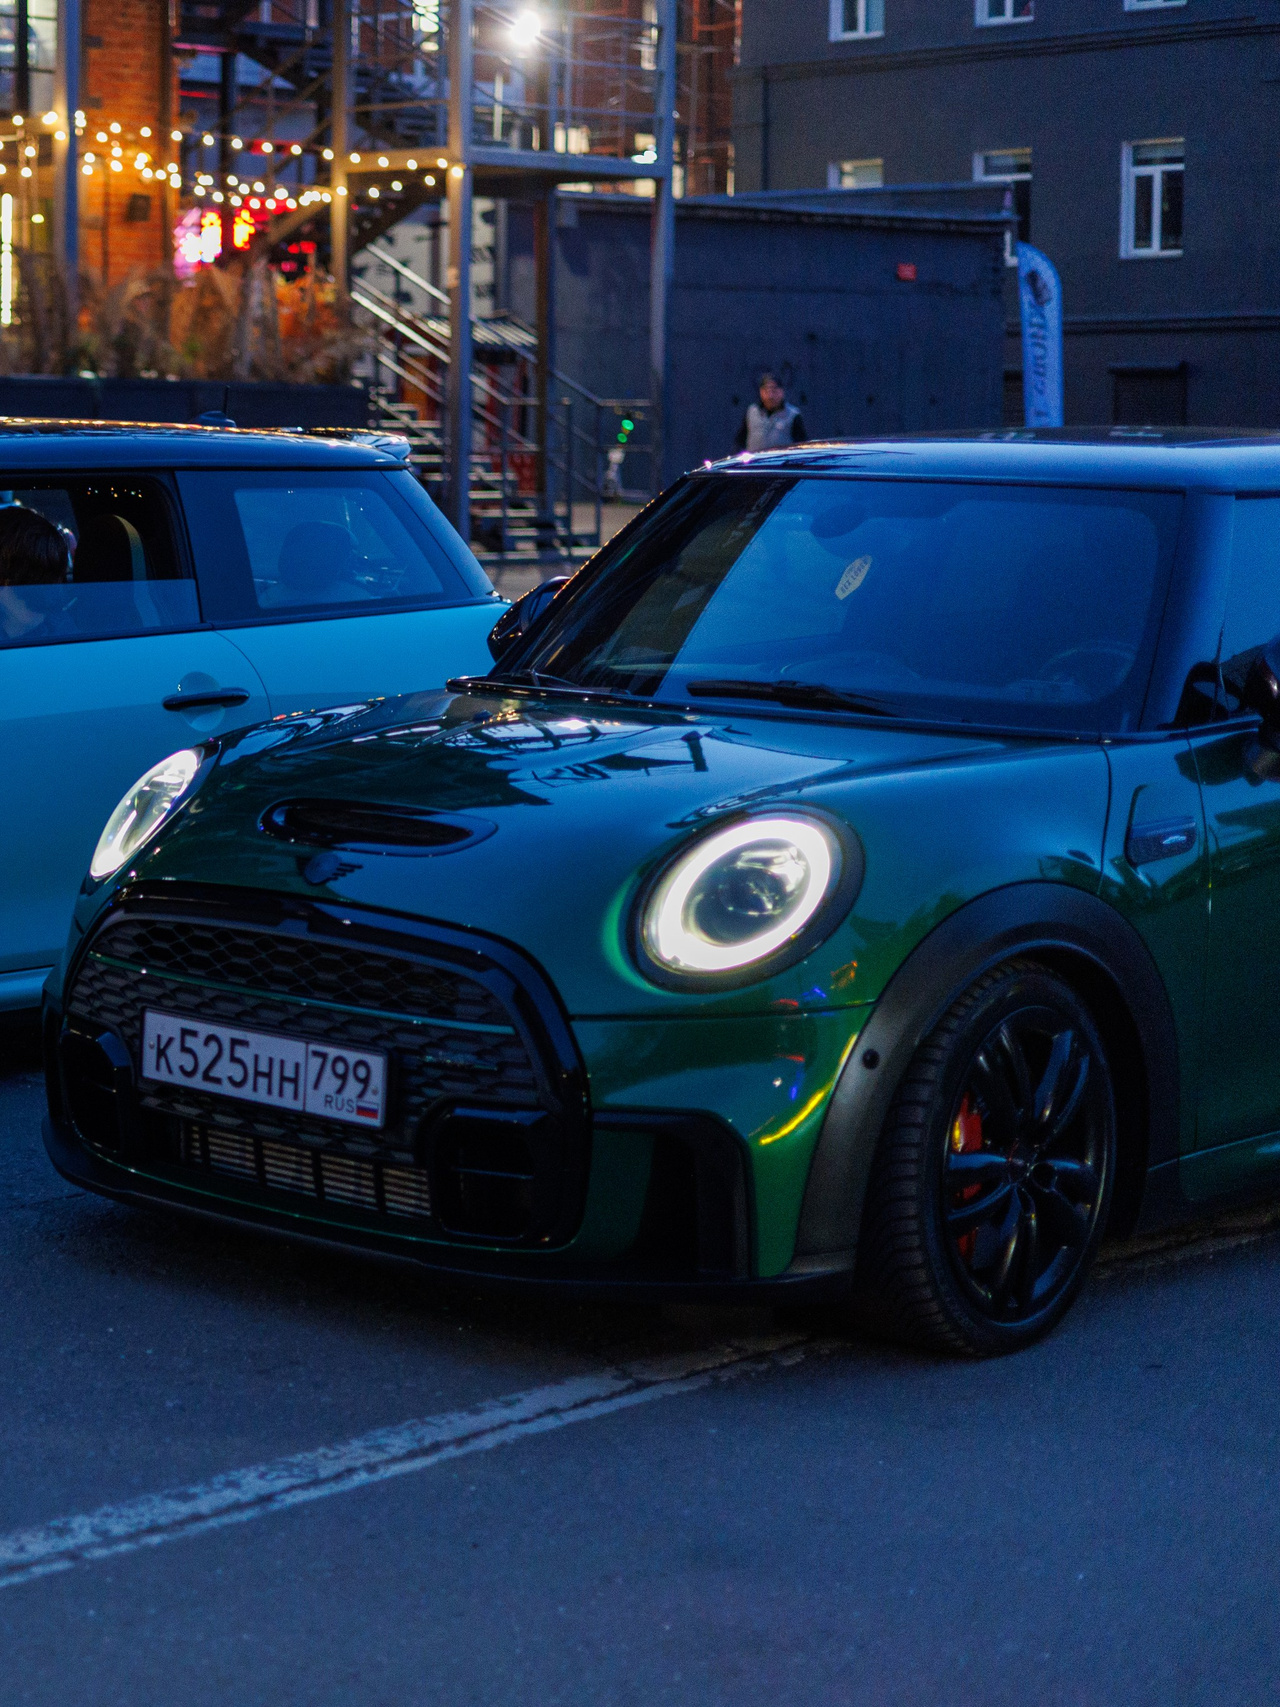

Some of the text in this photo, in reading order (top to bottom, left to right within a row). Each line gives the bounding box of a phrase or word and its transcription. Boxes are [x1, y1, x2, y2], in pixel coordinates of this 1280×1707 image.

[155, 1026, 372, 1102] K525HH 799
[324, 1094, 355, 1114] RUS
